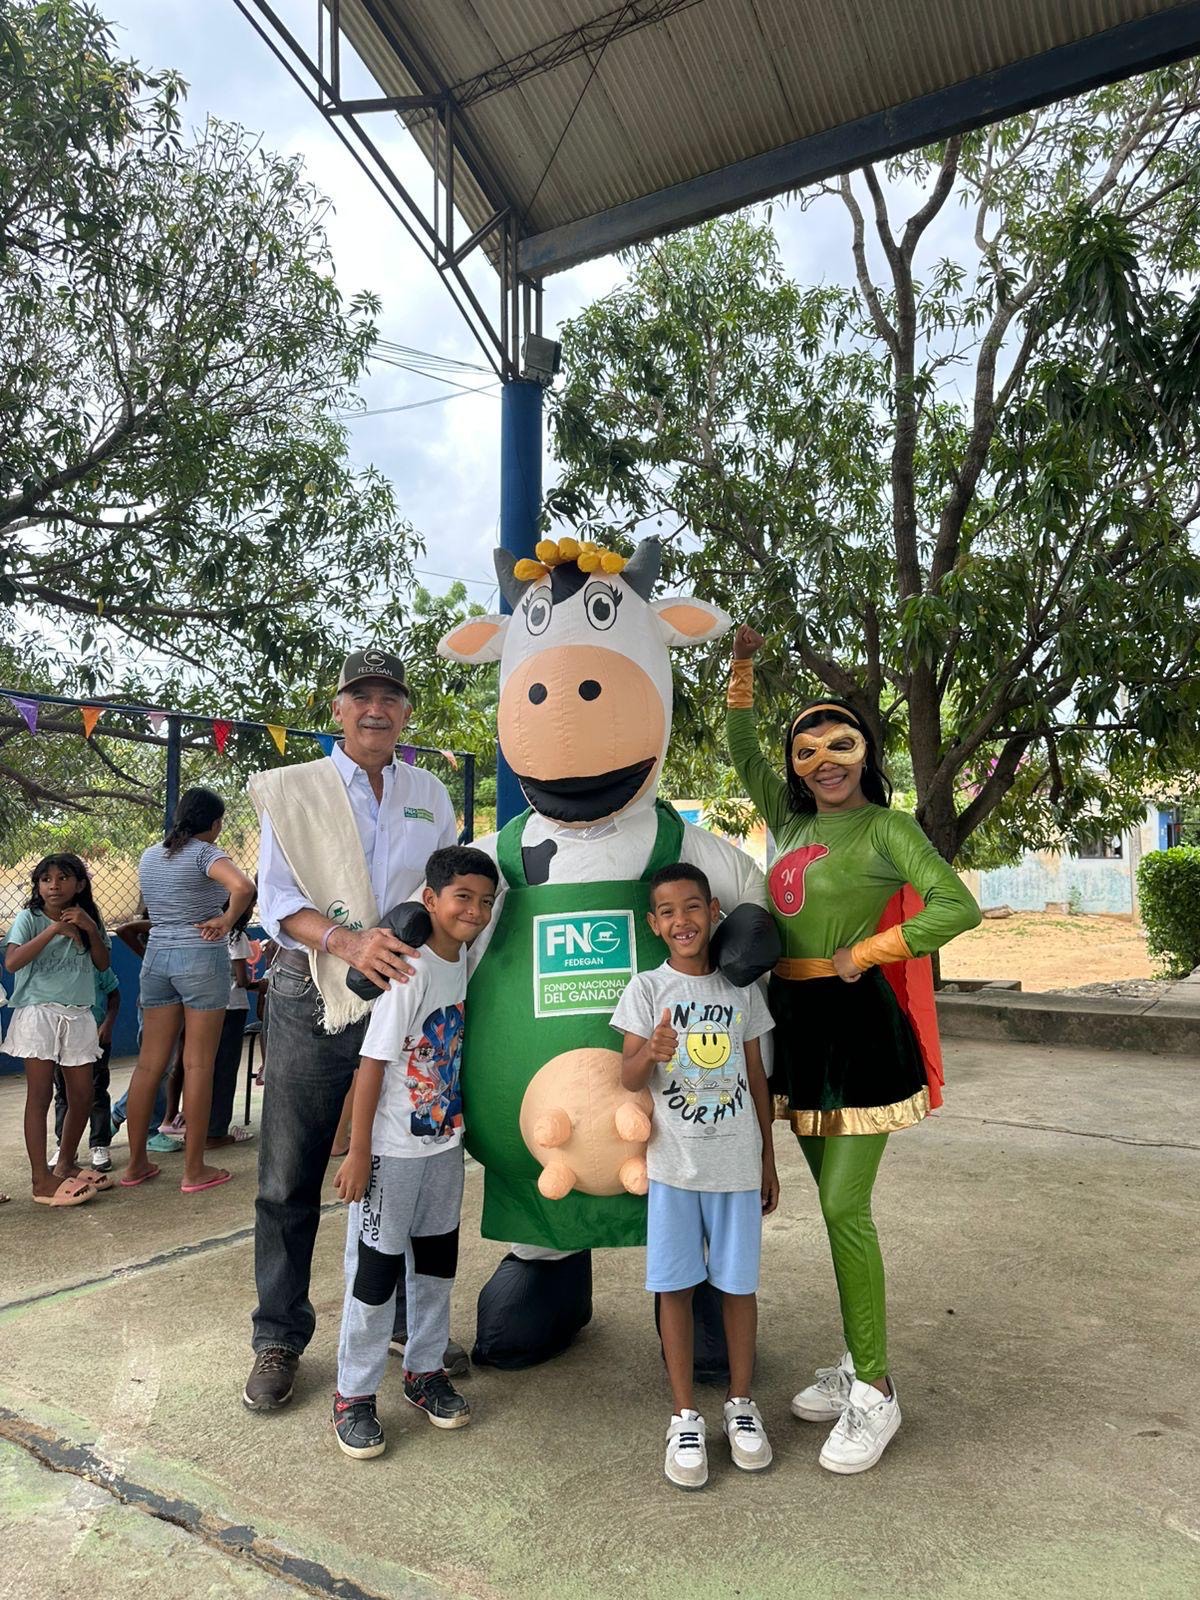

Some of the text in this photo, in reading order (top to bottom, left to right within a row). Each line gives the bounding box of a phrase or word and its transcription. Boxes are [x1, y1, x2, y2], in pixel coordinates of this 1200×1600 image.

[358, 666, 393, 677] FEDEGAN
[546, 921, 621, 957] FNG
[564, 957, 604, 967] FEDEGAN
[544, 979, 627, 992] FONDO NACIONAL
[544, 993, 566, 1004] DEL
[700, 1004, 733, 1027] JOY
[662, 1072, 747, 1124] YOUR HYPE
